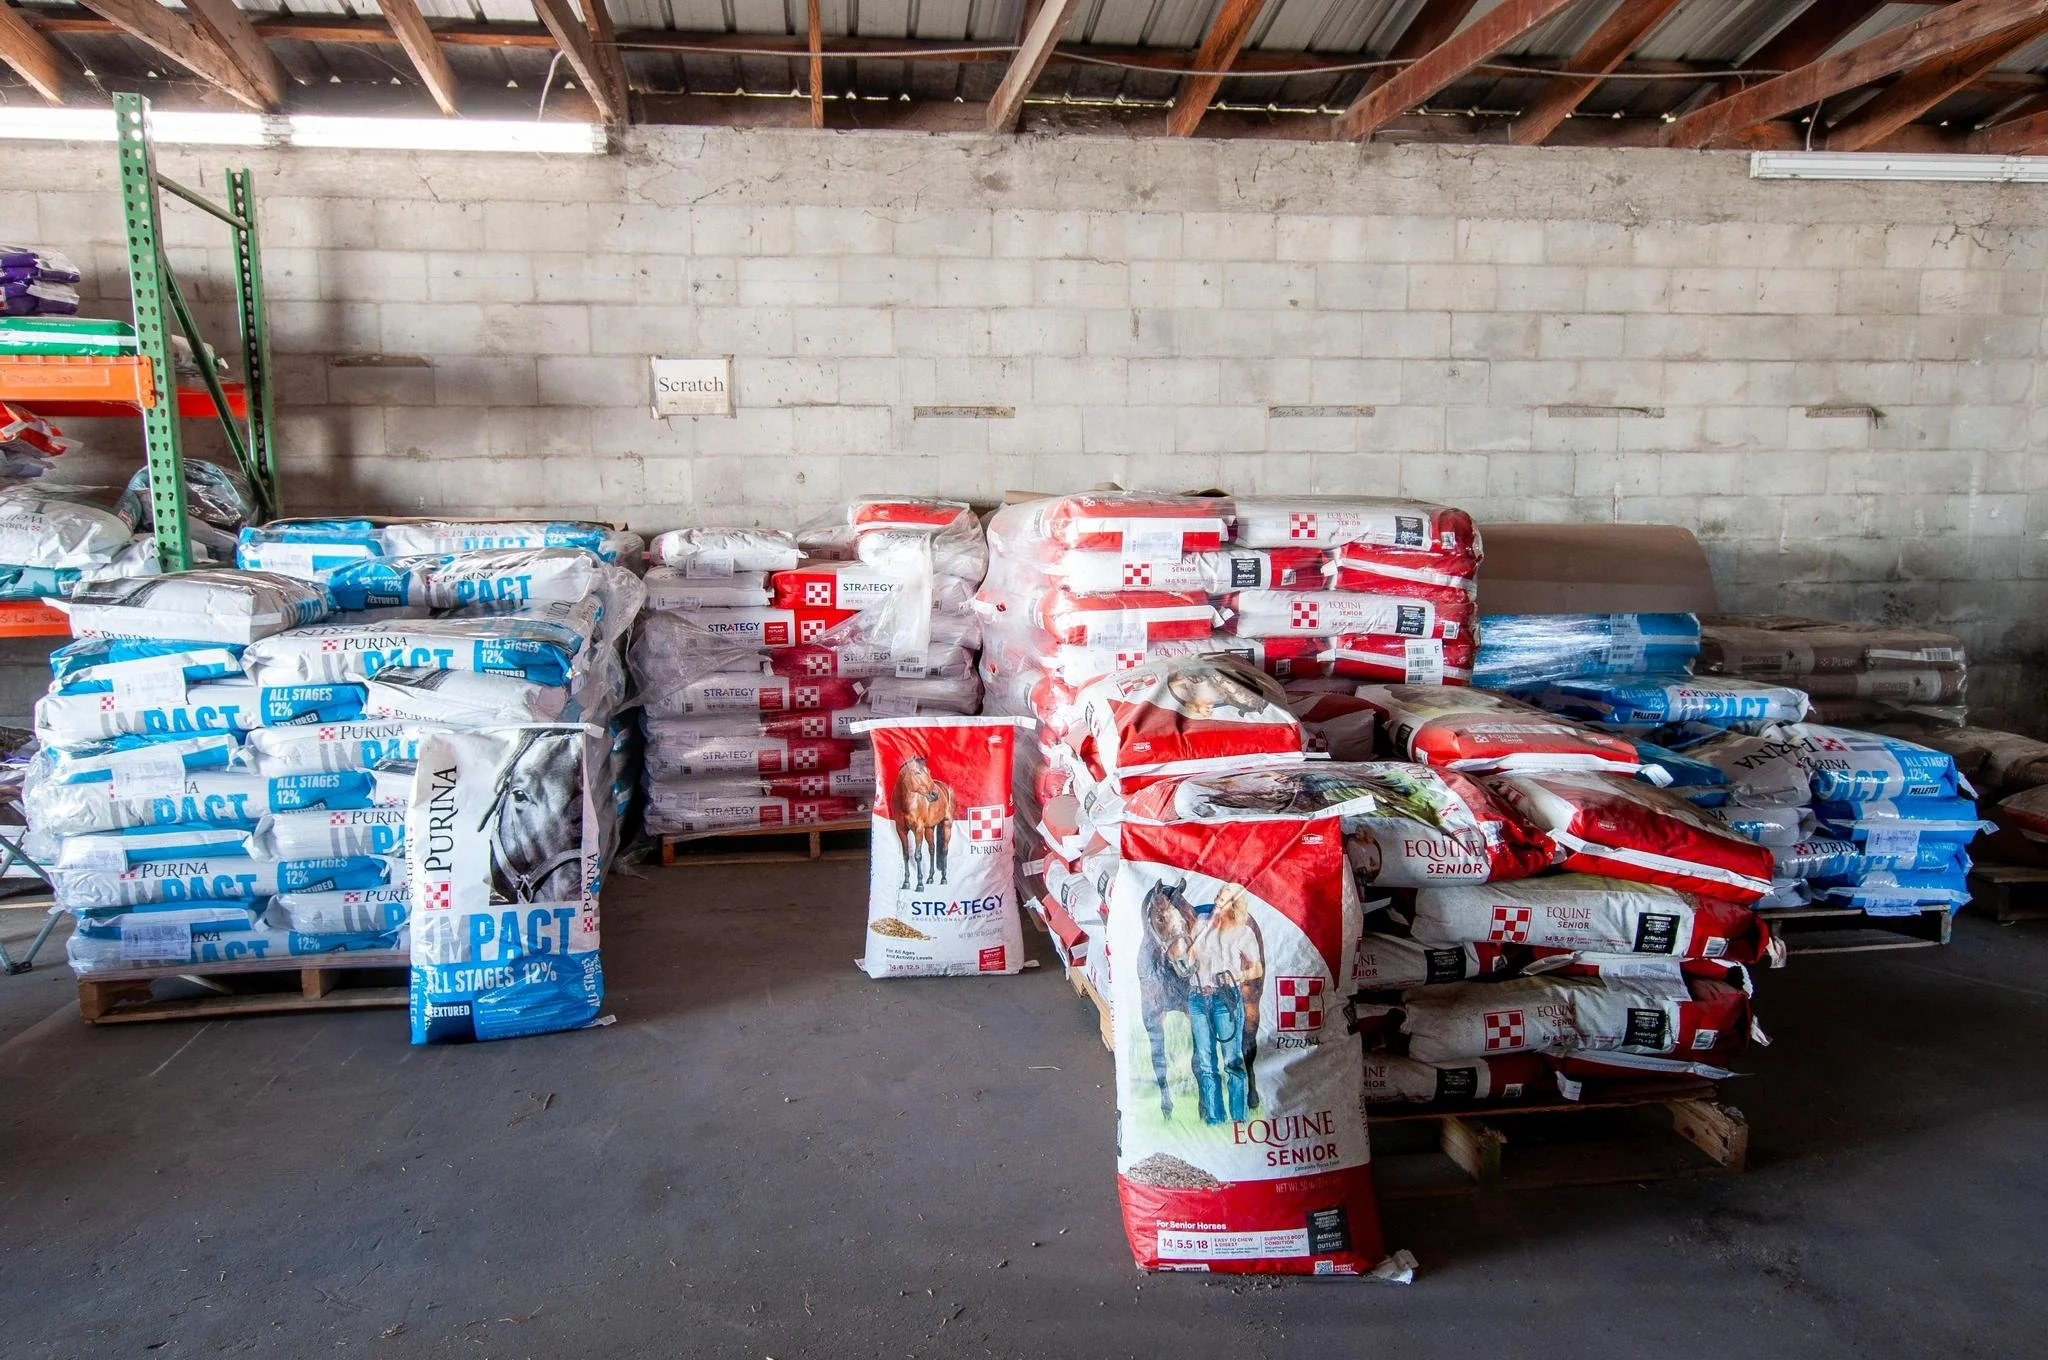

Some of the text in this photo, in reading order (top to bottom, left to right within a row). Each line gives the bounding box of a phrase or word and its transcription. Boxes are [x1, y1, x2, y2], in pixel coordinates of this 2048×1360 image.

[658, 376, 725, 392] Scratch
[383, 580, 402, 592] 12%
[842, 582, 894, 592] STRATEGY
[707, 622, 761, 634] STRATEGY
[343, 636, 409, 651] PURINA
[481, 640, 501, 649] ALL
[481, 649, 505, 664] 12%
[268, 687, 333, 702] ALL STAGES
[703, 687, 756, 697] STRATEGY
[268, 702, 293, 718] 12%
[341, 725, 405, 740] PURINA
[702, 750, 753, 760] STRATEGY
[1904, 756, 1950, 768] ALL STAGES
[1799, 757, 1851, 770] PURINA
[275, 774, 340, 789] ALL STAGES
[275, 789, 301, 805] 12%
[351, 810, 407, 826] PURIN
[704, 806, 756, 816] STRATEGY
[424, 765, 458, 874] PURINA
[330, 825, 406, 857] IMP
[970, 844, 1003, 855] PURINA
[1404, 838, 1483, 862] EQUINE
[141, 862, 209, 879] PURINA
[1426, 863, 1483, 875] SENIOR
[284, 870, 309, 885] 12%
[583, 852, 598, 913] PURINA
[911, 892, 1004, 916] STRATEGY
[343, 902, 407, 933] IMP
[1546, 906, 1592, 921] EQUINE
[1557, 920, 1590, 929] SENIOR
[424, 906, 578, 965] IMPACT
[425, 960, 558, 995] ALL STAGES 12%
[581, 956, 601, 1007] ALL STAGES
[1276, 1036, 1324, 1049] PURINA
[1364, 1065, 1387, 1078] INE
[1233, 1110, 1336, 1148] EQUINE
[1266, 1143, 1339, 1167] SENIOR
[1275, 1182, 1288, 1193] NET
[1156, 1219, 1227, 1230] For Senior Horses
[1162, 1237, 1209, 1250] 14 5.5 18
[1317, 1241, 1343, 1249] OUTLAST
